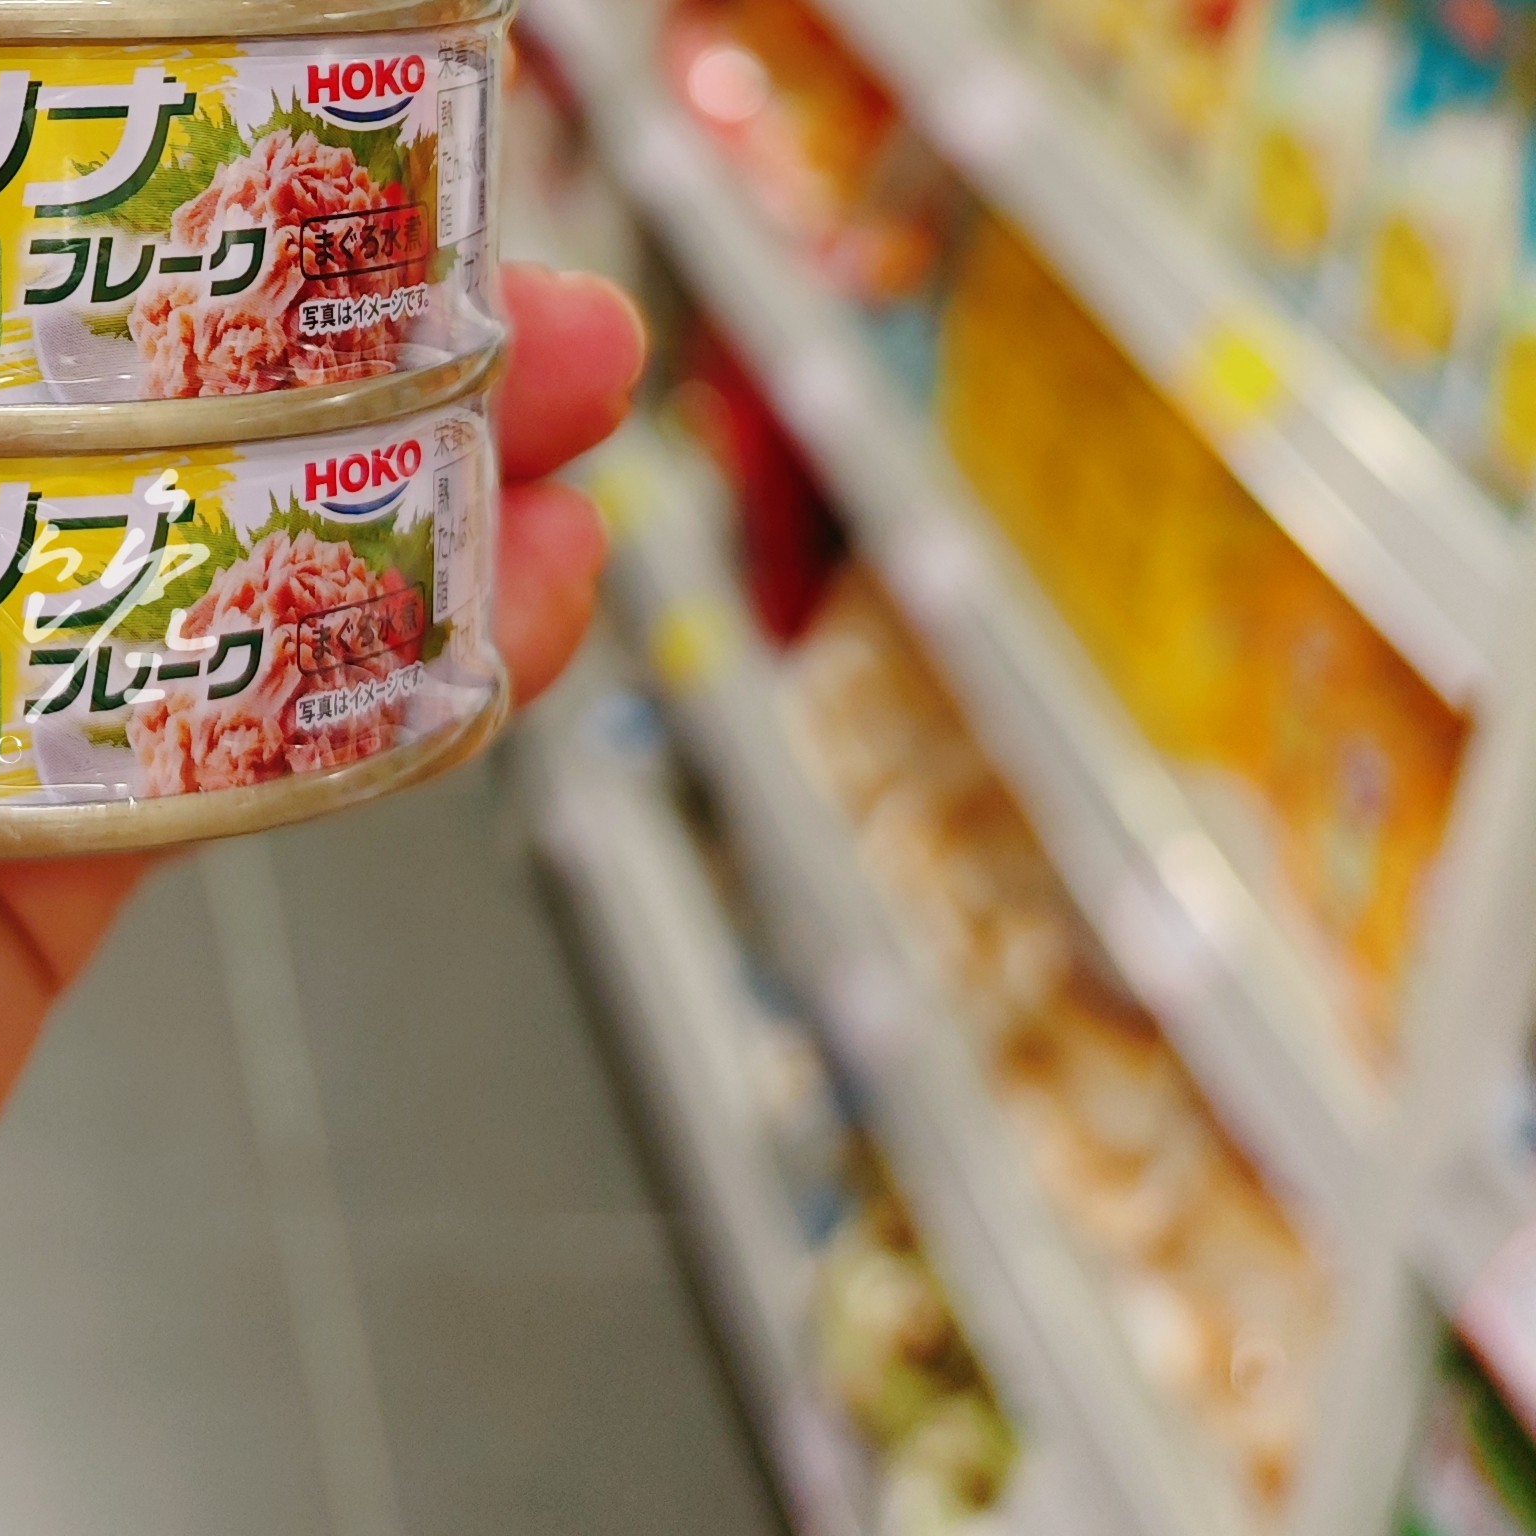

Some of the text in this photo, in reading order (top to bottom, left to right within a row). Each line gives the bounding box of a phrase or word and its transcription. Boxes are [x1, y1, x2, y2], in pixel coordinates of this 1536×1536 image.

[307, 54, 425, 104] HOKO
[24, 227, 266, 305] フレーク
[313, 216, 423, 266] まぐろ水煮
[305, 439, 422, 501] HOKO
[24, 628, 264, 716] フレーク
